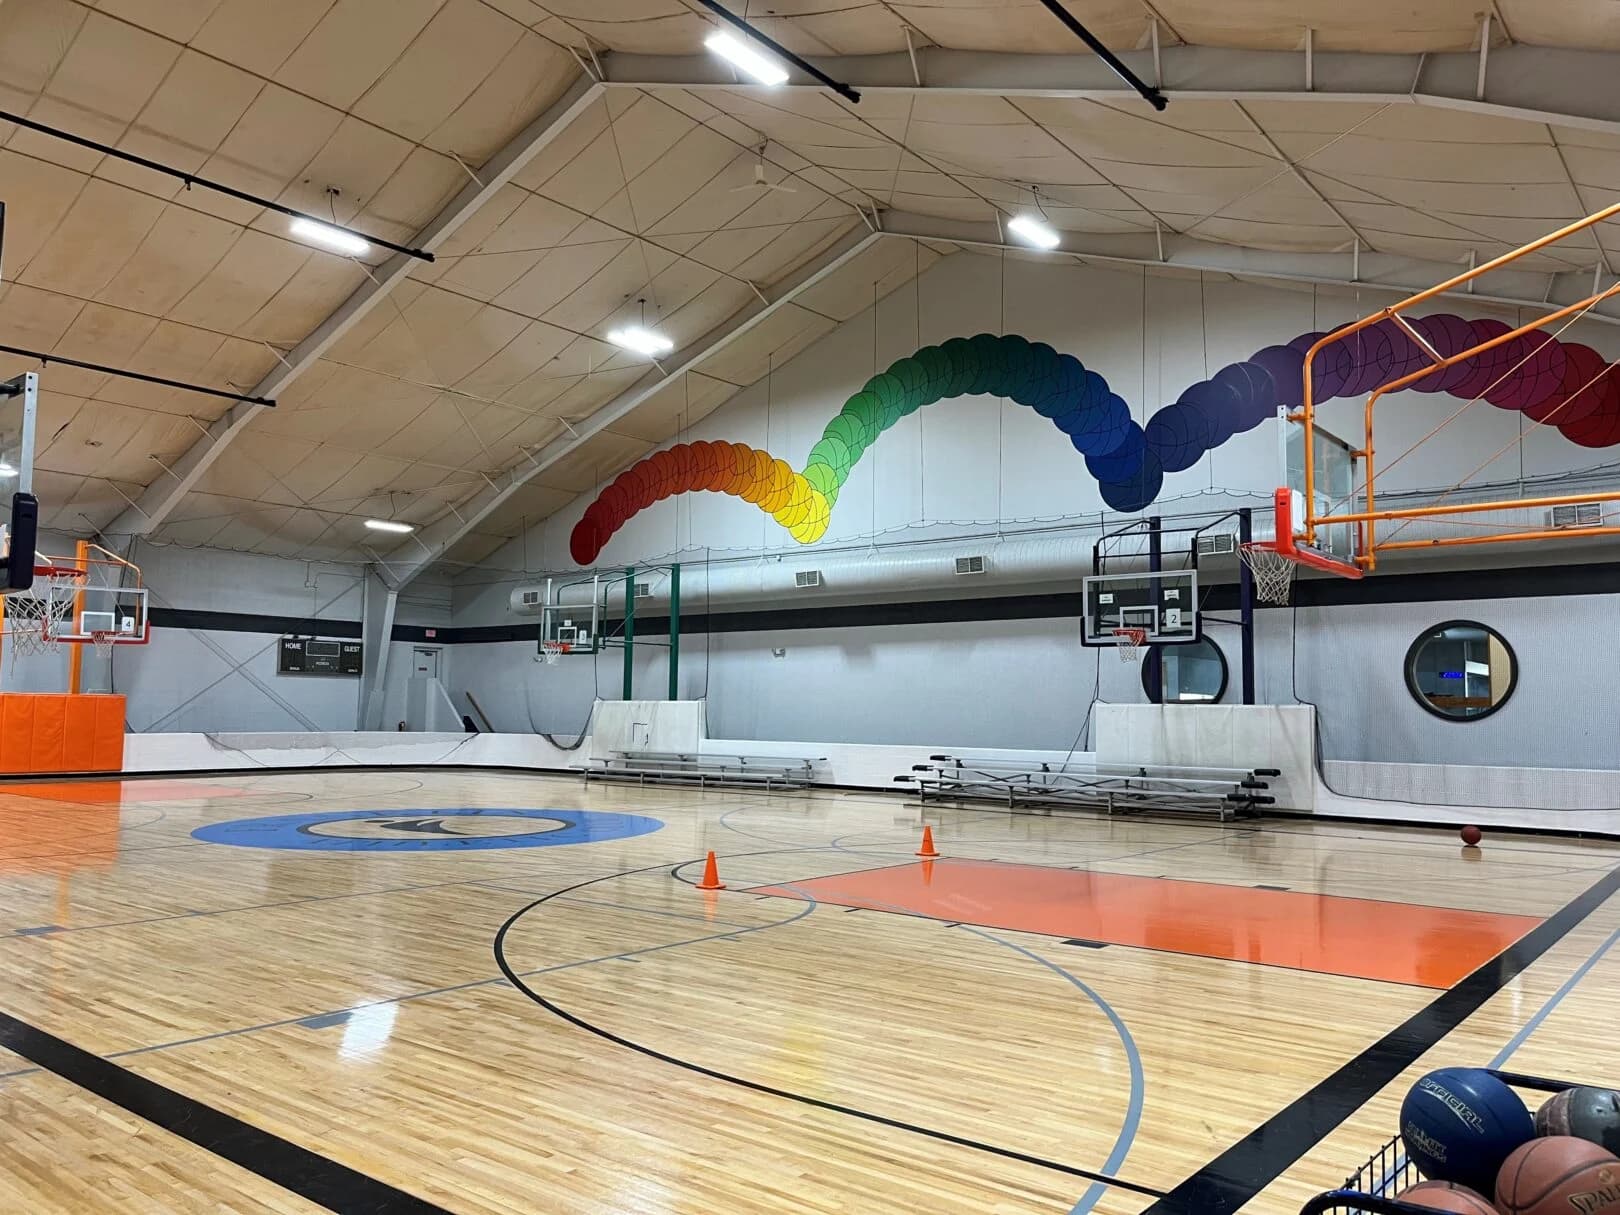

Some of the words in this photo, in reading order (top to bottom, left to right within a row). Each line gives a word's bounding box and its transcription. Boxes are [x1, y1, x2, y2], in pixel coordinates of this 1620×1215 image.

[1171, 614, 1177, 624] 2
[125, 620, 131, 628] 4
[285, 642, 302, 650] HOME
[344, 645, 361, 653] GUEST
[1419, 1078, 1485, 1135] OFFICIAL
